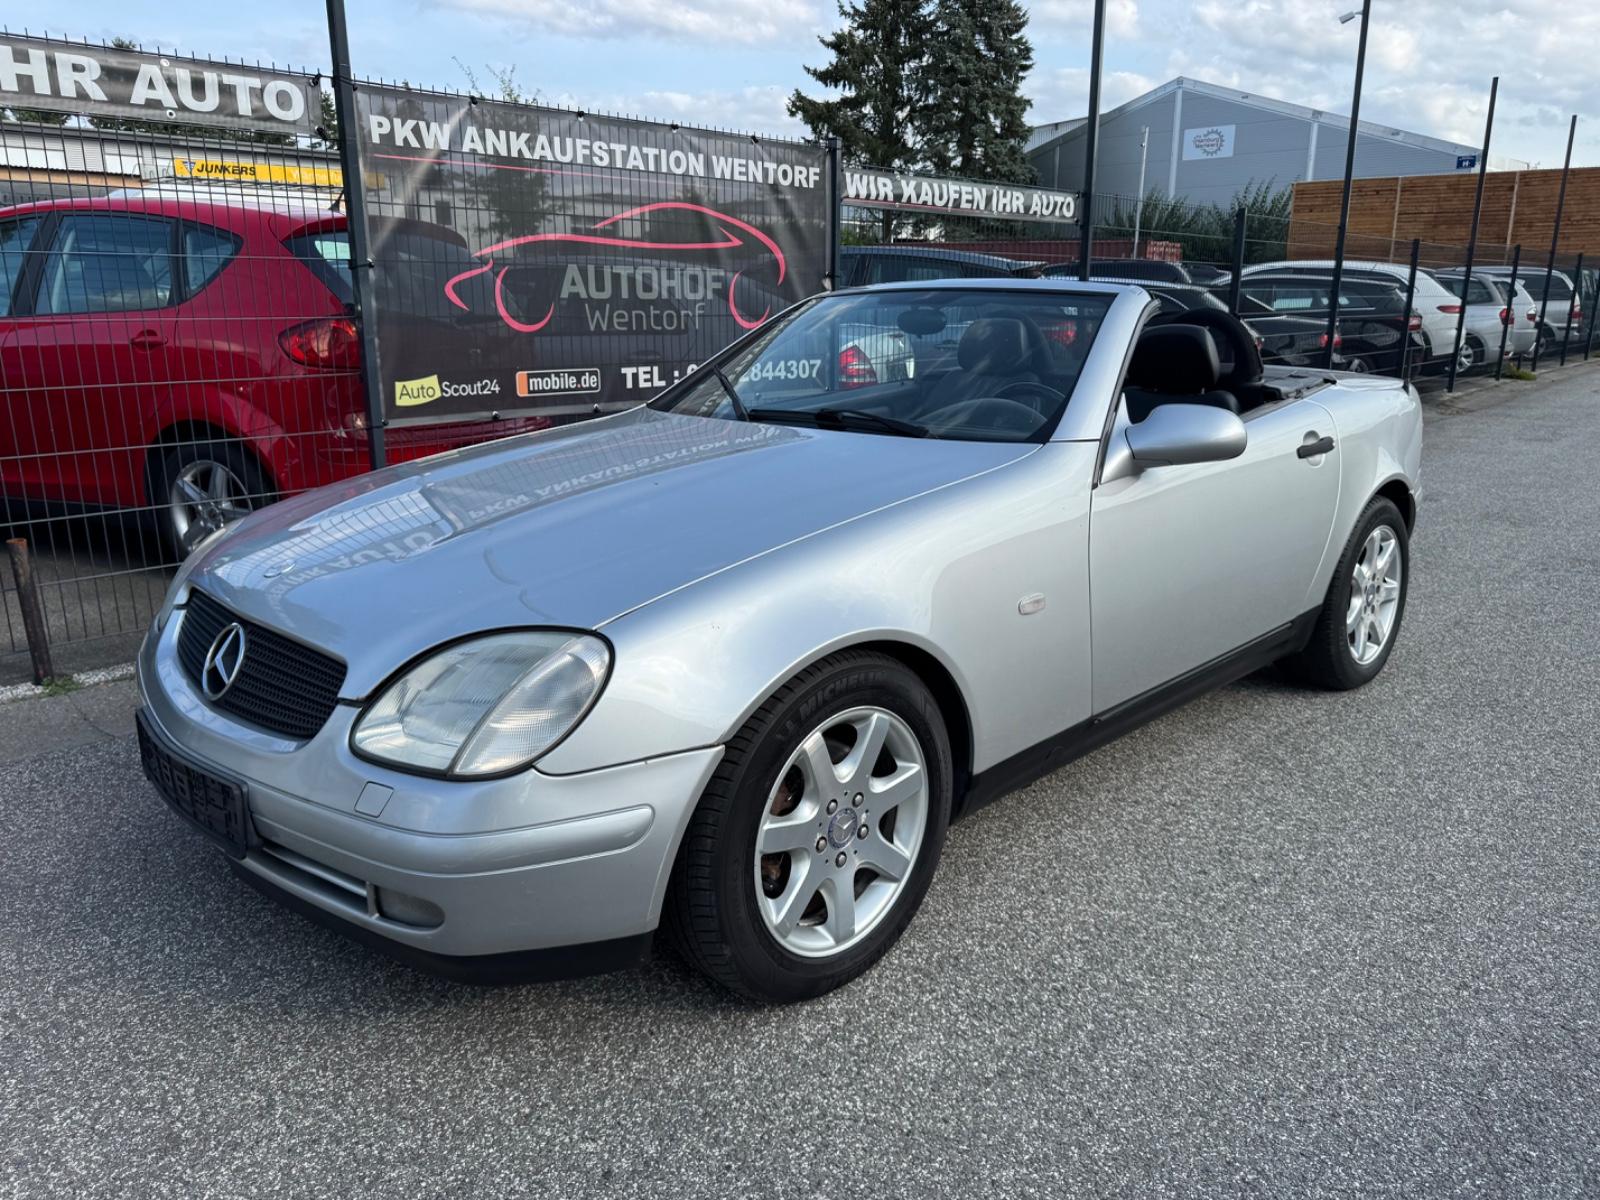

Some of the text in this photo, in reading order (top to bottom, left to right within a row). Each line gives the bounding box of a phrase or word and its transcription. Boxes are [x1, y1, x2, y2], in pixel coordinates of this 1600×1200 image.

[130, 63, 305, 121] AUTO
[369, 115, 820, 189] PKW ANKAUFSTATION WENTORF
[197, 163, 256, 176] JUNKERS
[845, 172, 894, 201] WIR
[992, 187, 1024, 214] IHR
[1029, 193, 1075, 218] AUTO
[560, 263, 725, 300] AUTOHOF
[585, 303, 706, 331] Wentorf
[529, 372, 598, 391] mobile.de
[621, 366, 666, 389] TEL
